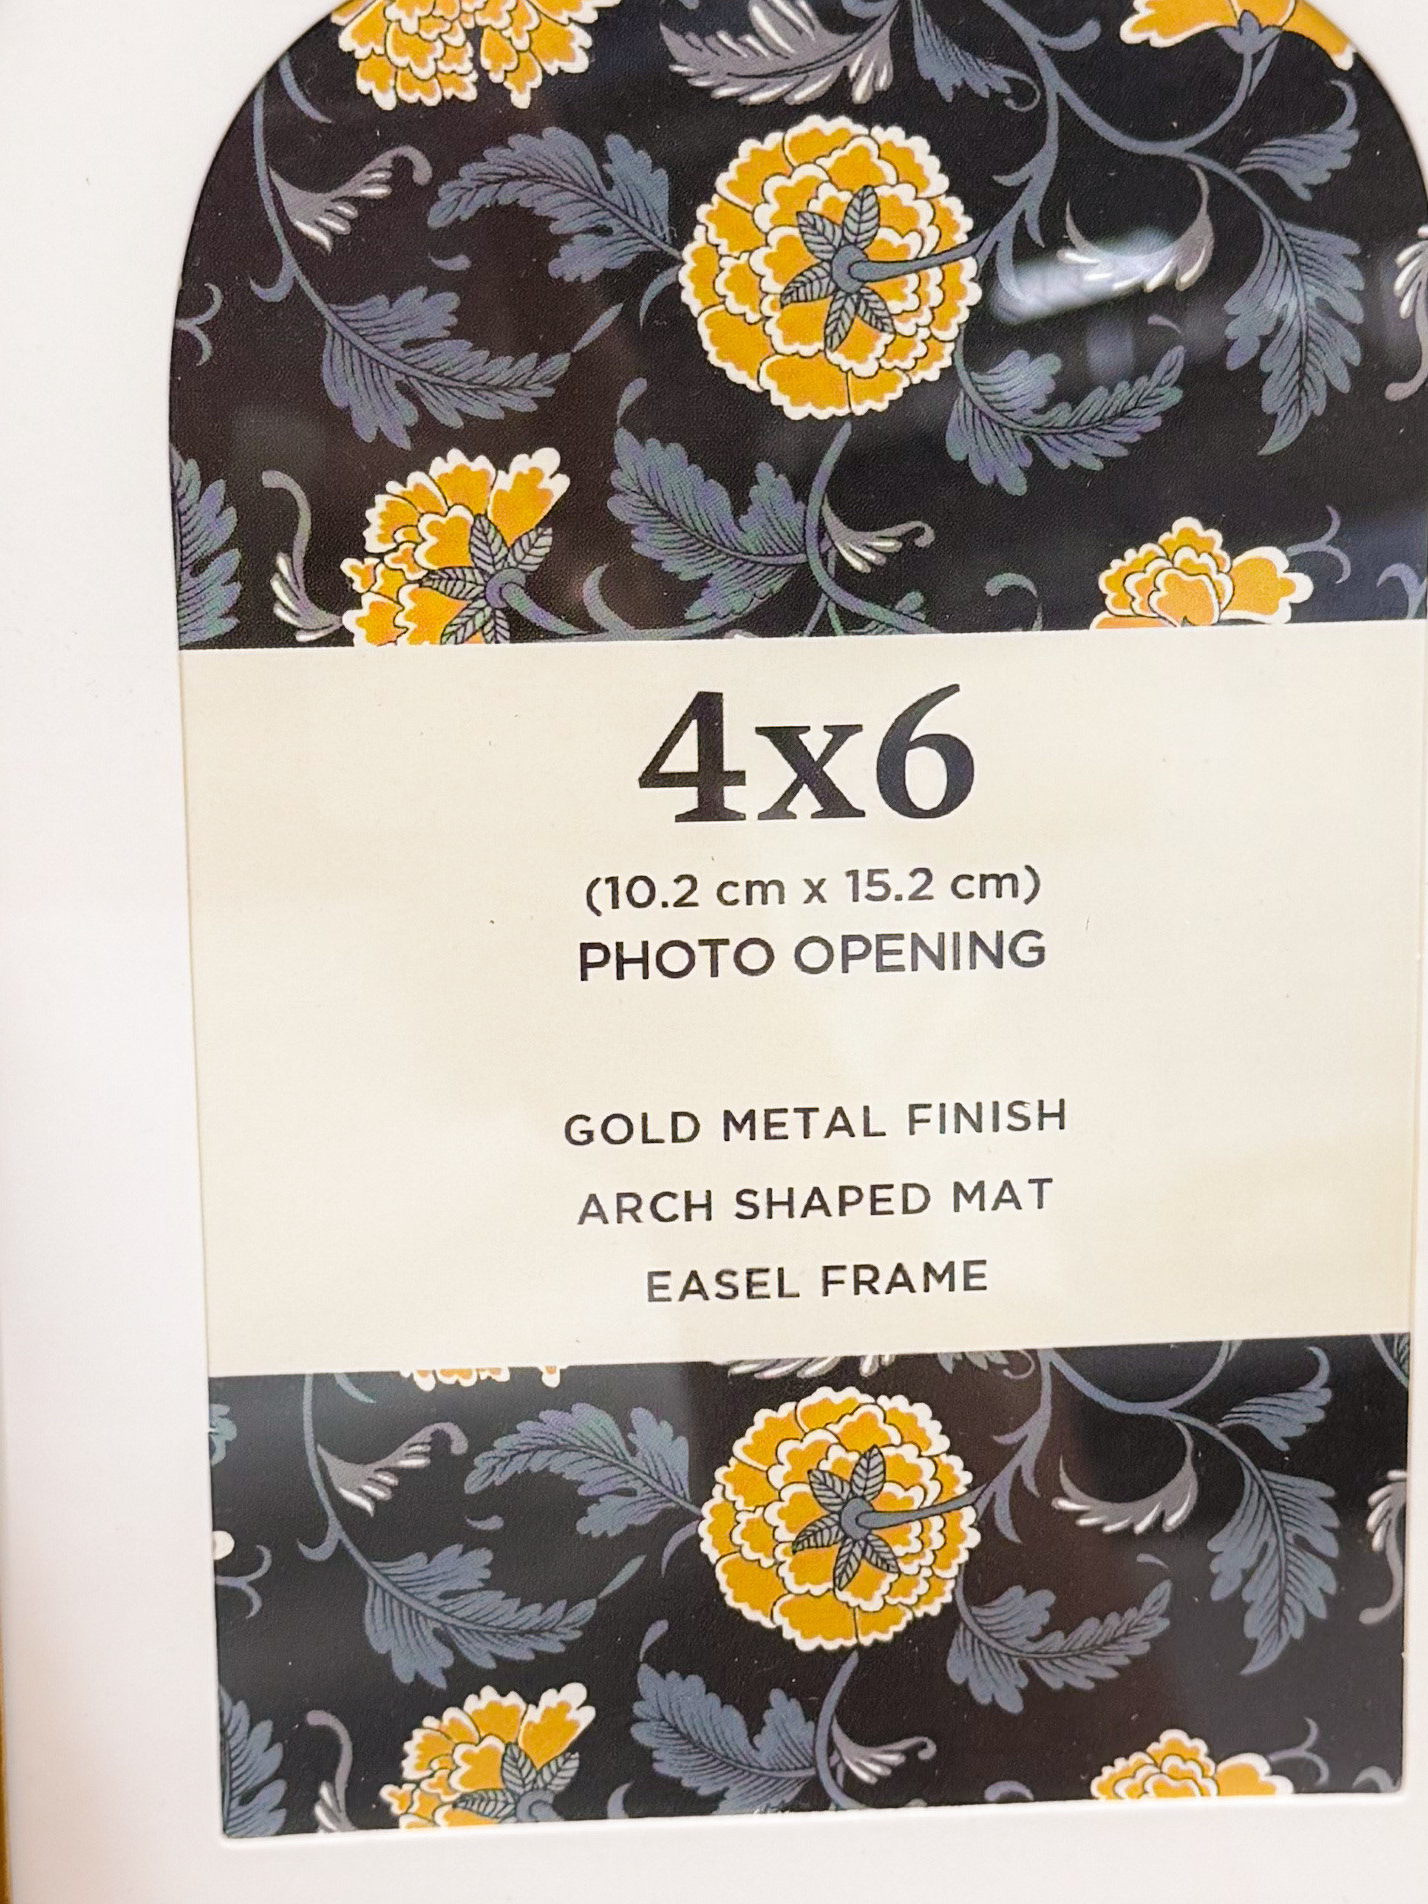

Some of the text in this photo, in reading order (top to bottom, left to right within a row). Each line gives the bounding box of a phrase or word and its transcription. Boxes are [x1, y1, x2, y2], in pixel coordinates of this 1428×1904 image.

[638, 683, 975, 823] 4x6
[585, 864, 1042, 918] (10.2 cm x 15.2 cm)
[580, 929, 1046, 982] PHOTO OPENING
[564, 1097, 1066, 1147] GOLD METAL FINISH
[577, 1177, 1054, 1226] ARCH SHAPED MAT
[647, 1259, 988, 1303] EASEL FRAME
